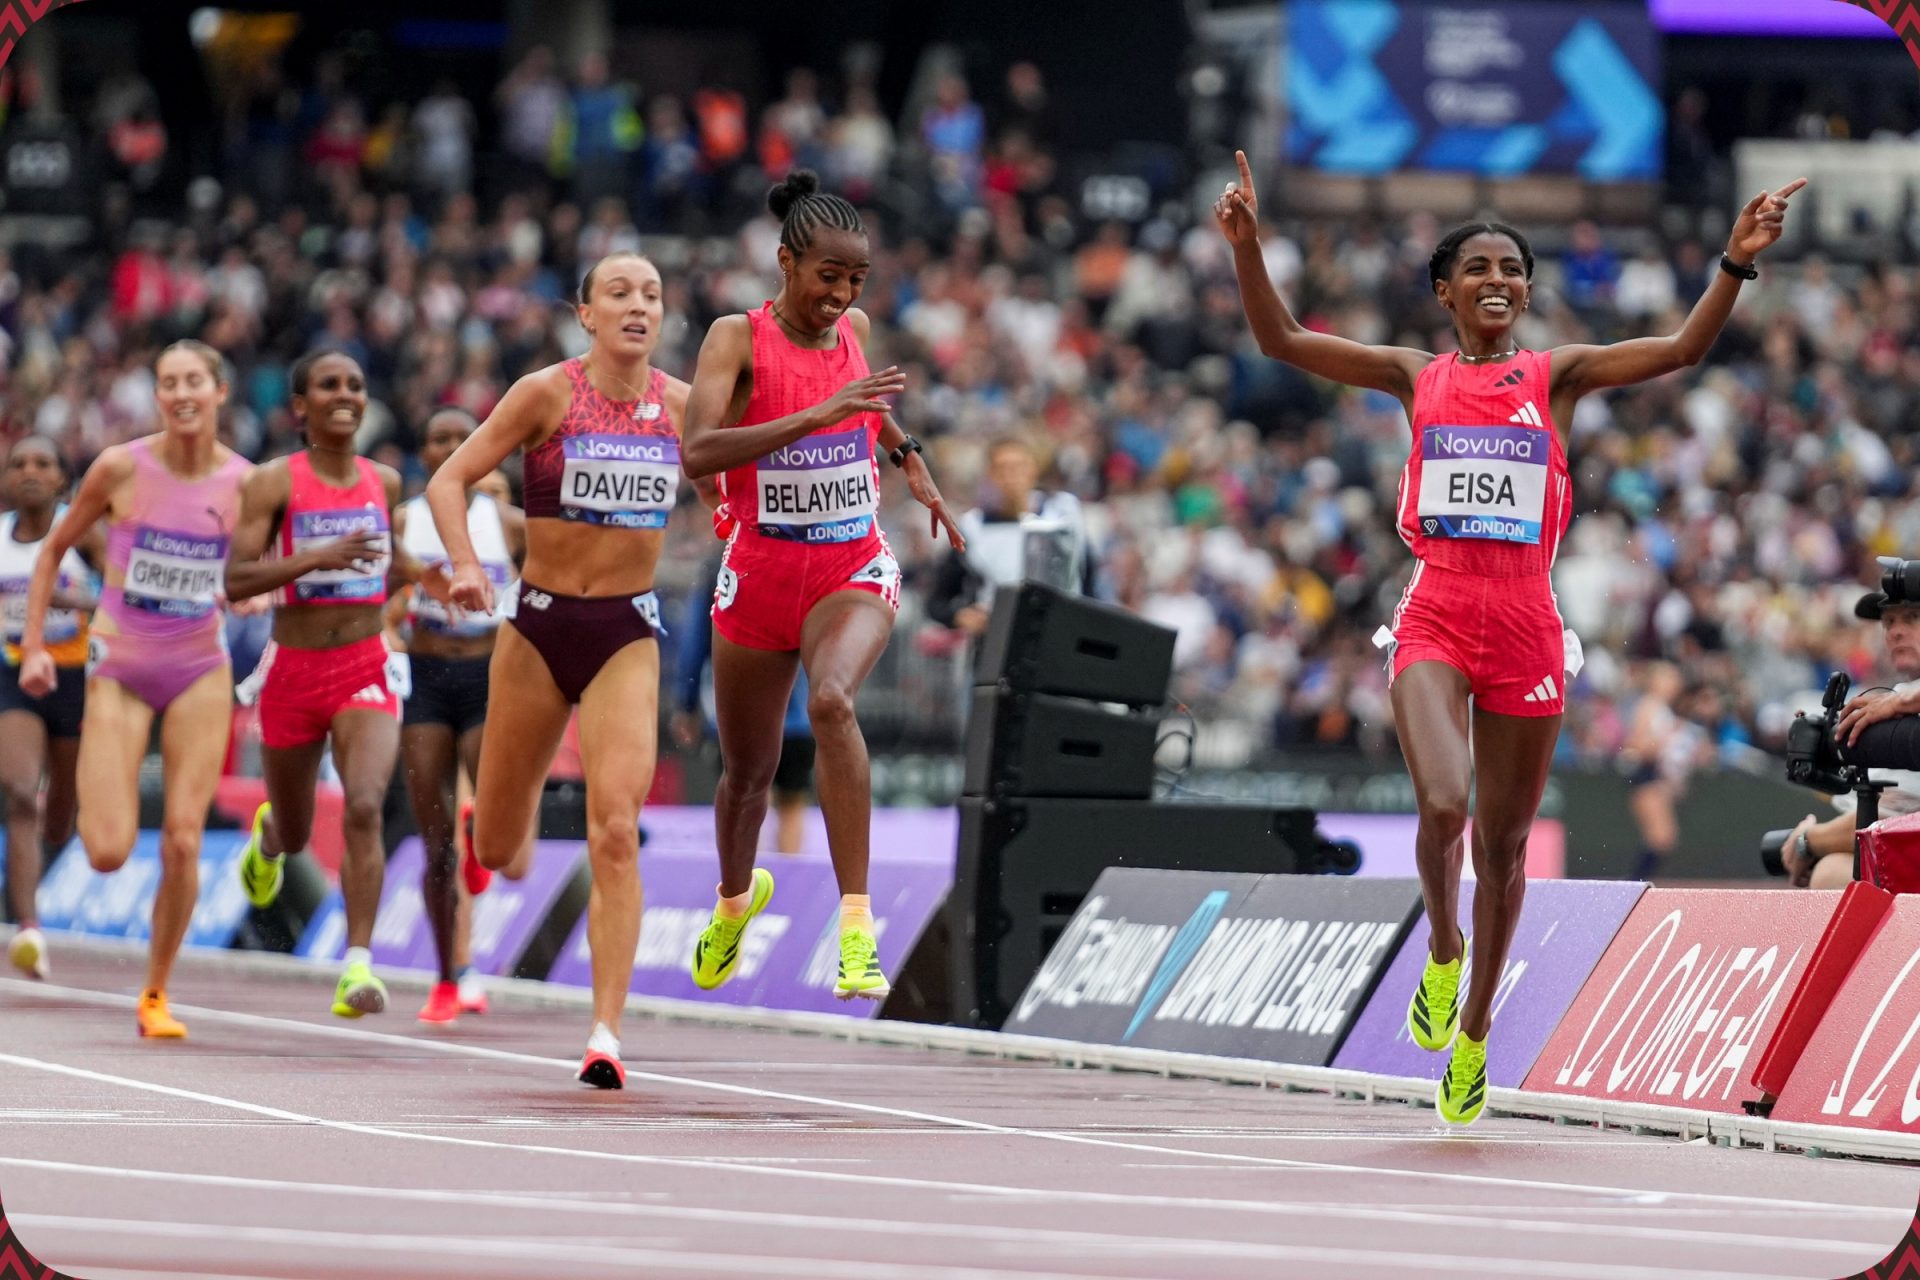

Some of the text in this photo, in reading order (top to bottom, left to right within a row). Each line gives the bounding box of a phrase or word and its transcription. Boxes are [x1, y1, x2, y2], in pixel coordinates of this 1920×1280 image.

[575, 439, 663, 460] Novuna
[770, 442, 856, 466] Novuna
[1434, 432, 1532, 458] Novuna
[573, 471, 667, 503] DAVIES
[765, 474, 871, 513] BELAYNEH
[1448, 472, 1516, 507] EISA
[603, 513, 657, 527] LONDON
[807, 520, 868, 541] LONDON
[1461, 519, 1526, 538] LONDON
[133, 559, 217, 594] GRIFFITH
[1154, 918, 1310, 1028] DIAMOND
[1252, 921, 1400, 1037] LEAGUE
[1606, 942, 1805, 1101] OMEGA
